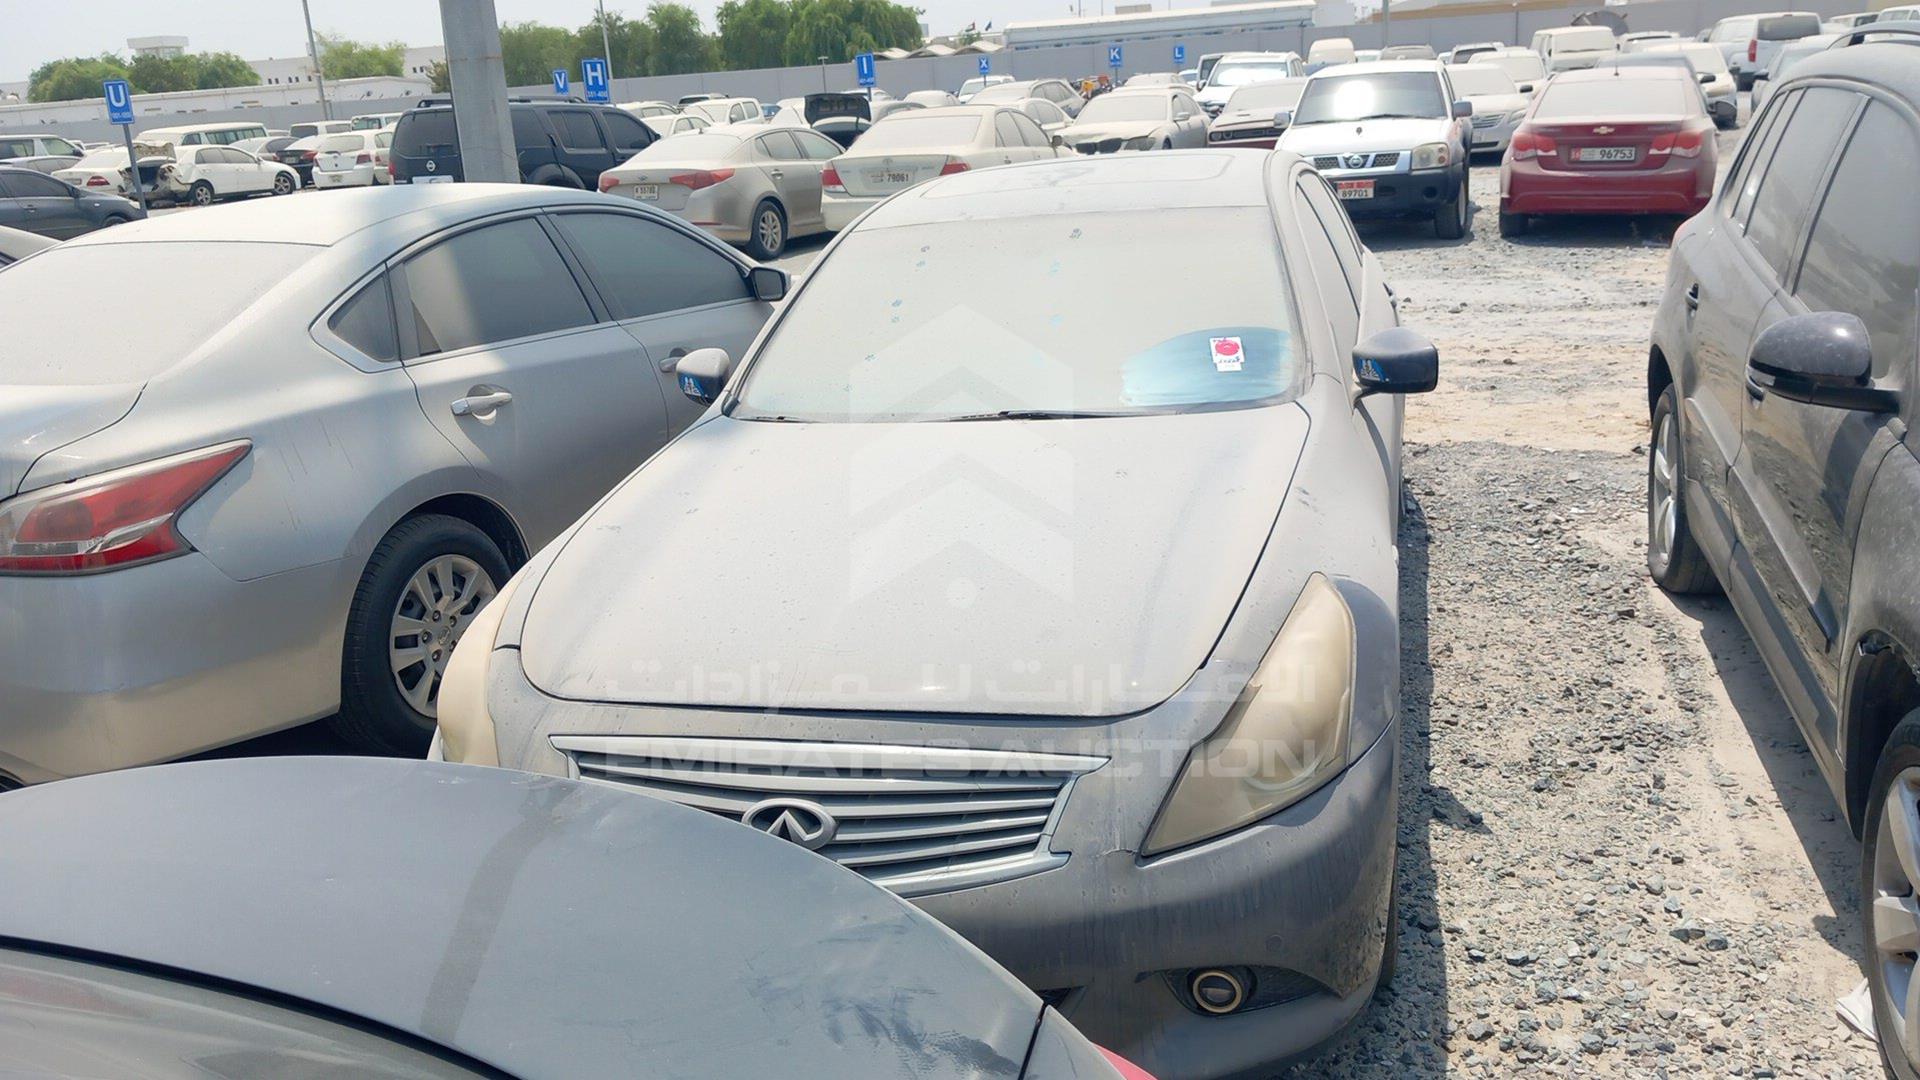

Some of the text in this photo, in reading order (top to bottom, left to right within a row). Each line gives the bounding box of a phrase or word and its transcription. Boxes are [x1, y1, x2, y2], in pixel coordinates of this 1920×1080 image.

[1110, 48, 1120, 60] K
[1175, 47, 1182, 58] L
[862, 56, 868, 74] I
[980, 58, 988, 68] X
[585, 63, 604, 86] H
[554, 72, 565, 89] V
[108, 84, 126, 107] U
[1599, 149, 1633, 159] 96753
[887, 173, 909, 183] 79061
[1341, 189, 1369, 198] 89701
